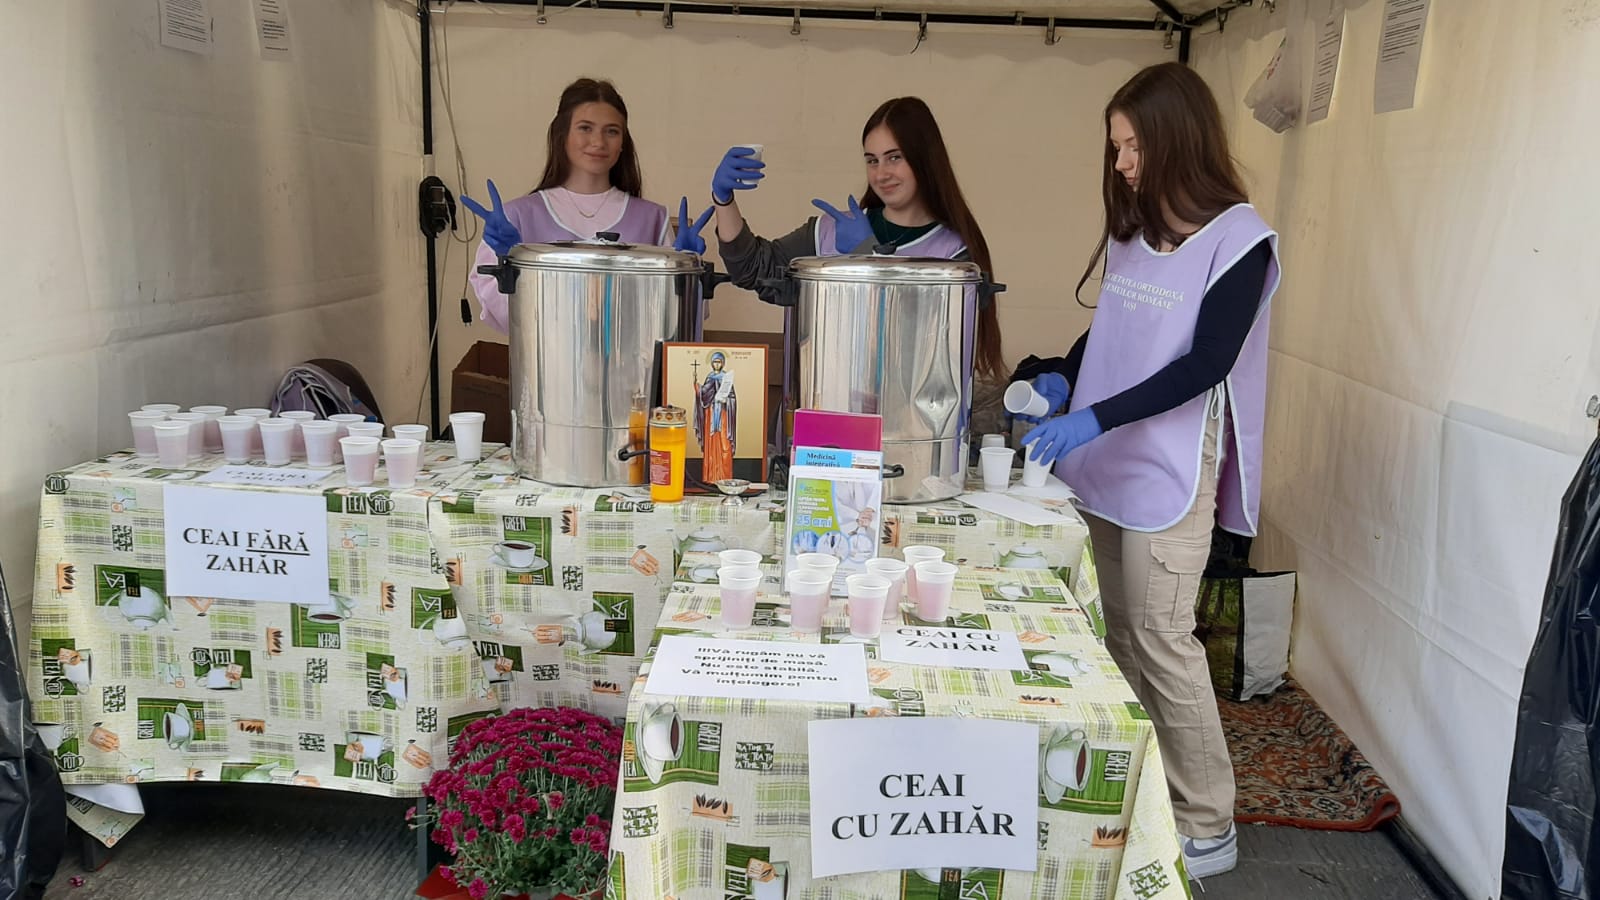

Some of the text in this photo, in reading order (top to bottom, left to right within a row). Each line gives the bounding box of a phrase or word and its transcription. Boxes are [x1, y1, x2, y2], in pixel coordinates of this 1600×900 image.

[182, 527, 310, 552] CEAI FĂRĂ
[206, 554, 289, 576] ZAHĂR
[896, 628, 1001, 642] CEAI CU
[905, 639, 999, 653] ZAHĂR
[735, 649, 782, 657] rugăm
[681, 668, 701, 676] Vă
[787, 674, 838, 682] pentru
[698, 722, 720, 752] GREEN
[1105, 751, 1129, 781] GREEN
[879, 773, 967, 799] CEAI
[831, 813, 880, 840] CU
[889, 804, 1017, 837] ZAHĂR
